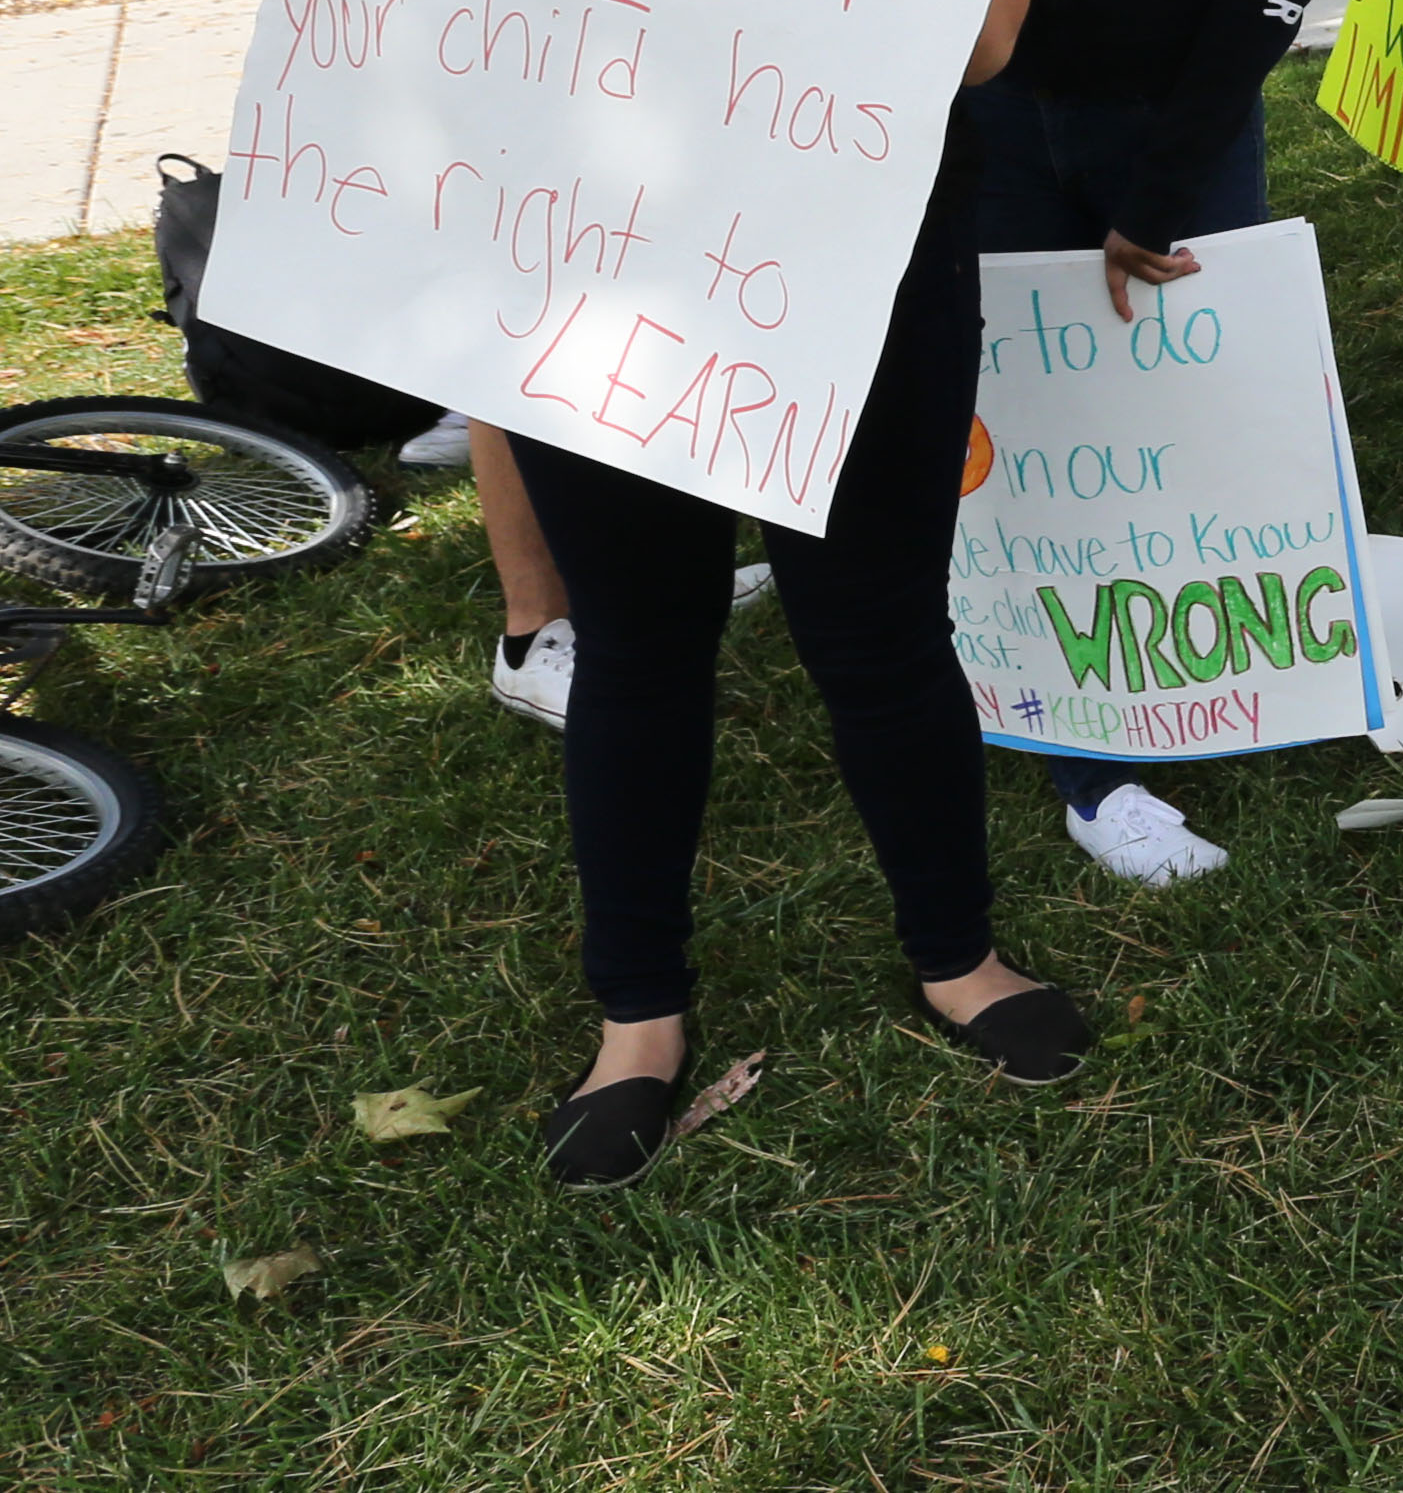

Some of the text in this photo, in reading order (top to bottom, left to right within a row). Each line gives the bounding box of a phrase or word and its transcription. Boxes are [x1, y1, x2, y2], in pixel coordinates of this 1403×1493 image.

[725, 30, 893, 161] has
[231, 95, 788, 338] the right to
[1018, 289, 1098, 374] to
[1131, 282, 1222, 371] do
[521, 293, 849, 514] LEARN!
[991, 434, 1176, 500] in our
[995, 517, 1119, 577] have
[1117, 521, 1174, 573] to
[993, 587, 1048, 640] did
[1036, 566, 1357, 693] WRONG
